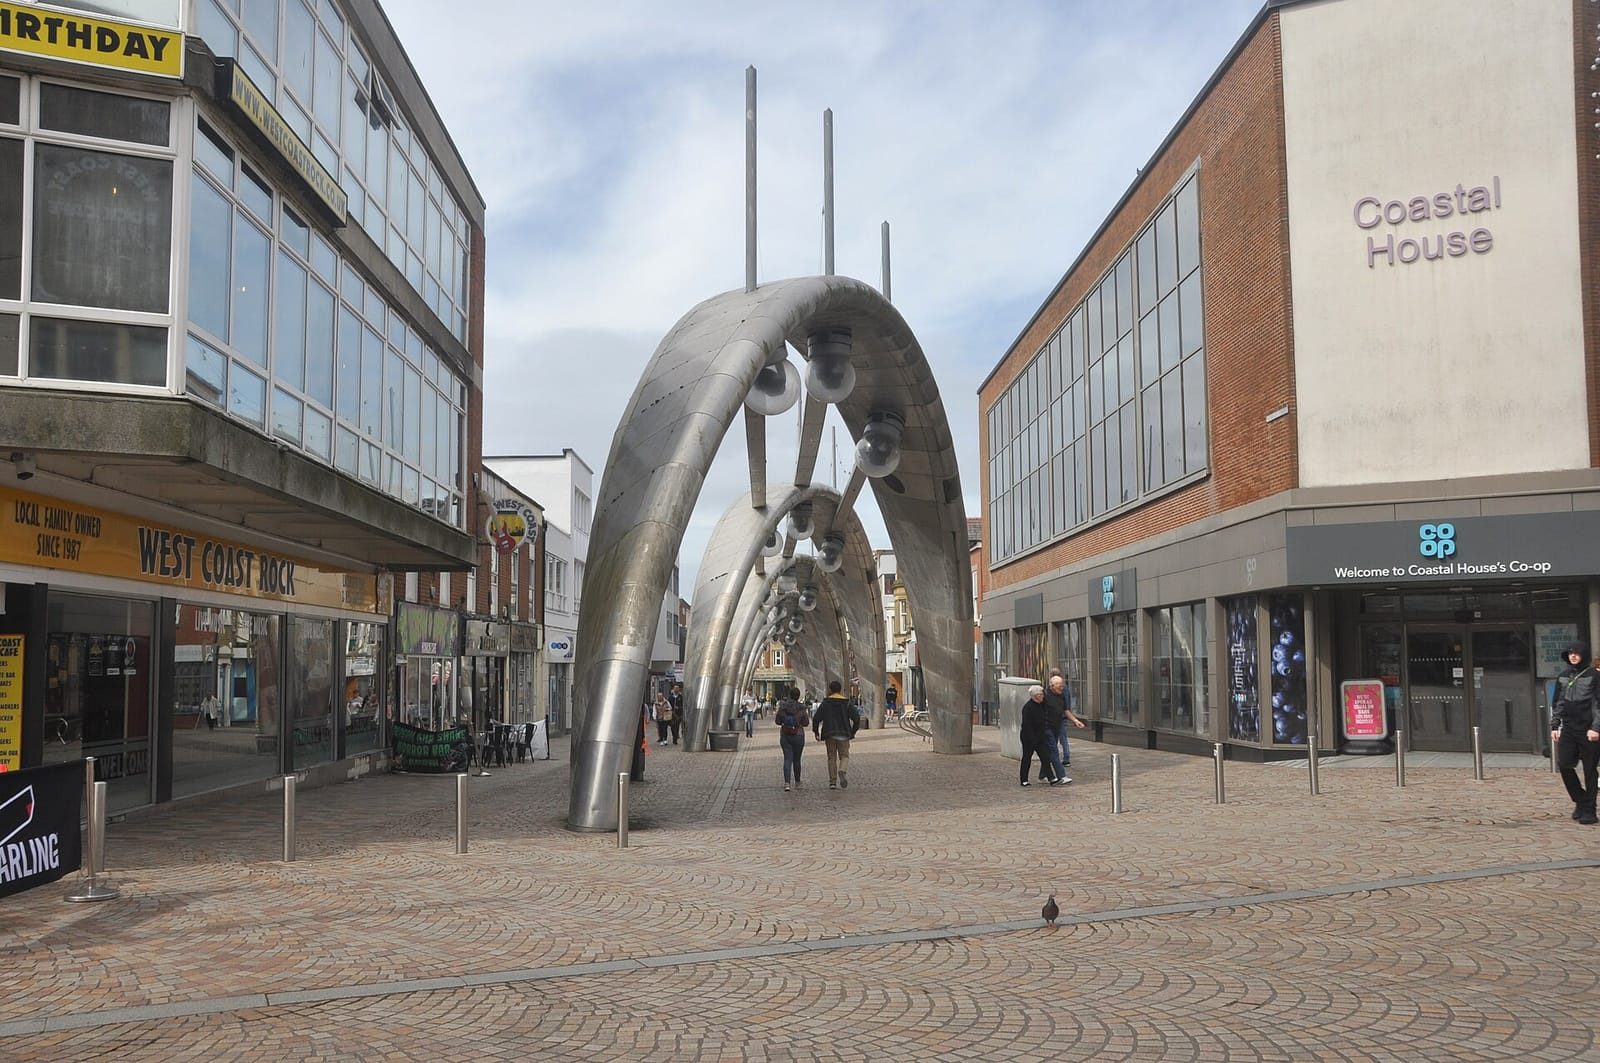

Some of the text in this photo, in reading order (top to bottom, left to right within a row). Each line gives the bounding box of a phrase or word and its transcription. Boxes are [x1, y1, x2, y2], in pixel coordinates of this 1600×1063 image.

[0, 8, 170, 62] IRTHDAY
[235, 75, 345, 217] WWW.WESTCOASTROCK.CO.UK
[1354, 176, 1501, 228] Coastal
[1367, 228, 1493, 268] House
[15, 500, 101, 538] LOCAL FAMILY OWNED
[493, 499, 537, 543] WEST COAST
[37, 533, 81, 561] SINCE 1987
[138, 527, 196, 580] WEST
[201, 541, 255, 588] COAST
[259, 553, 296, 596] ROCK
[1334, 560, 1551, 578] Welcome to Coastal House's Co-op
[0, 833, 60, 884] ARLING
